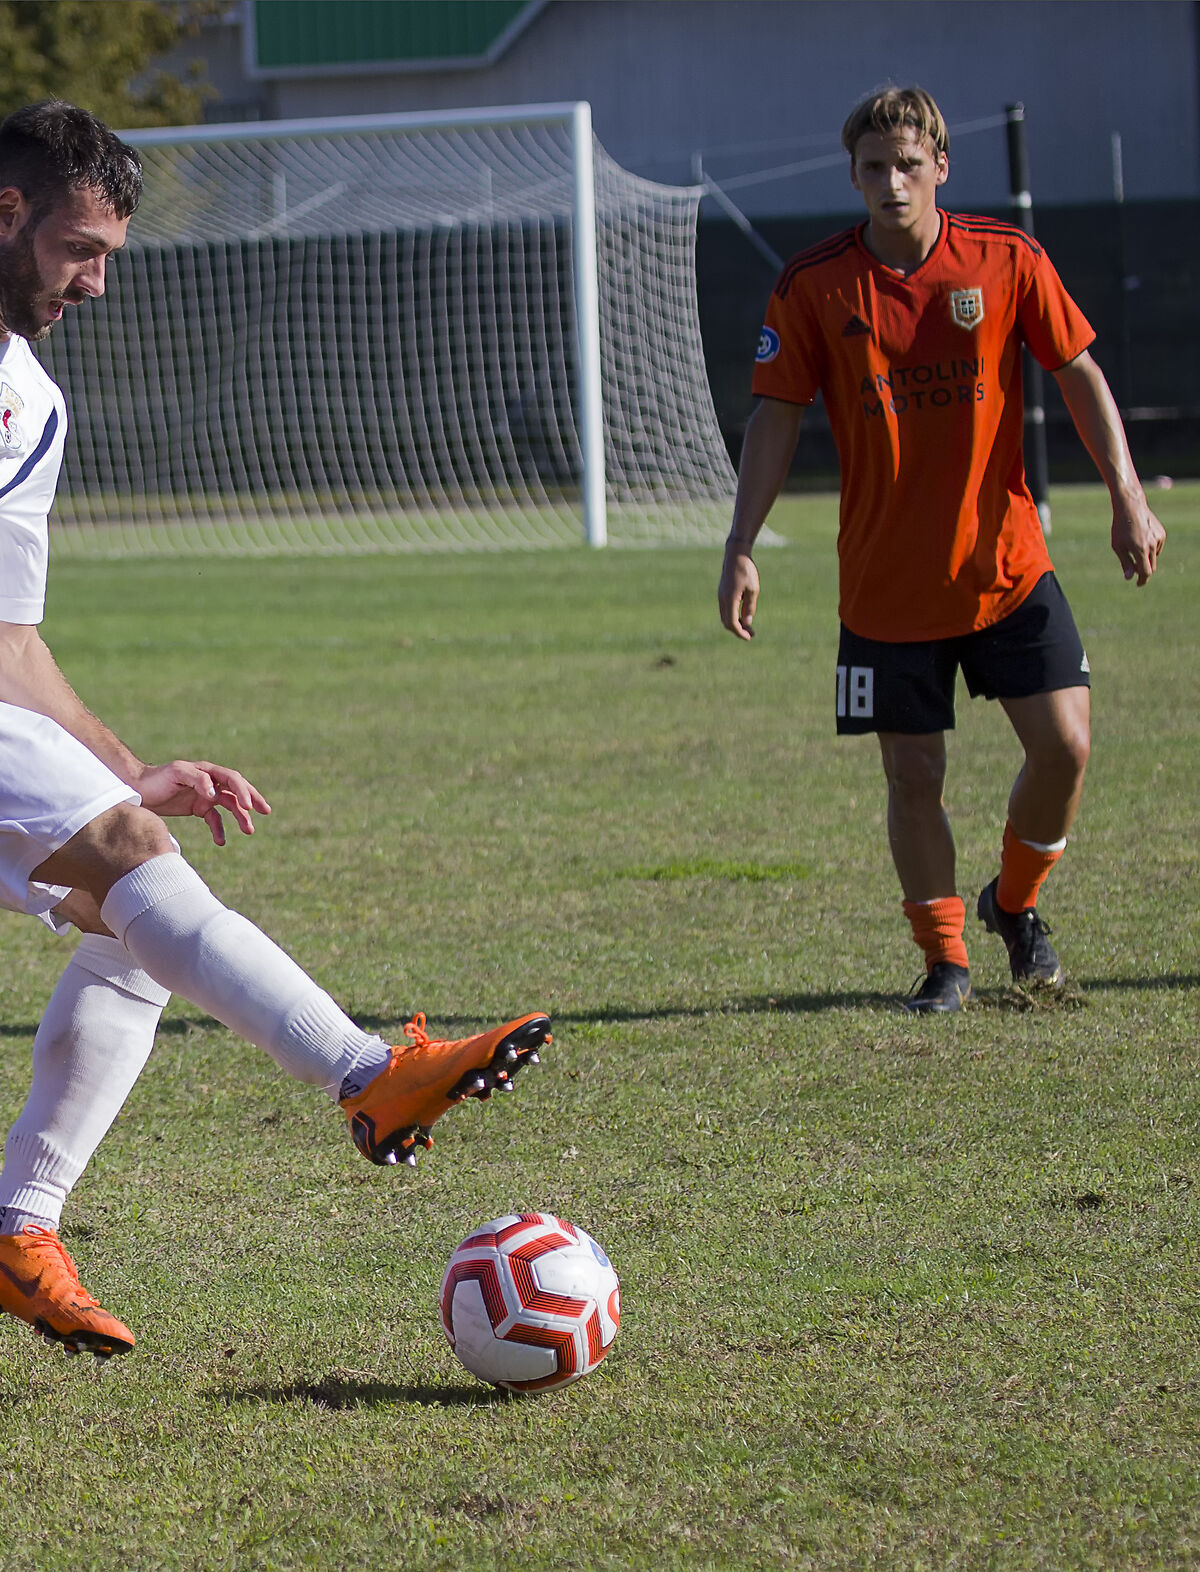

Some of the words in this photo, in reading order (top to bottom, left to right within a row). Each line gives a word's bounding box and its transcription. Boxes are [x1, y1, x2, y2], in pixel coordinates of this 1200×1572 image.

[860, 356, 984, 395] ANTOLINI
[862, 382, 984, 420] MOTORS
[836, 665, 874, 718] 18
